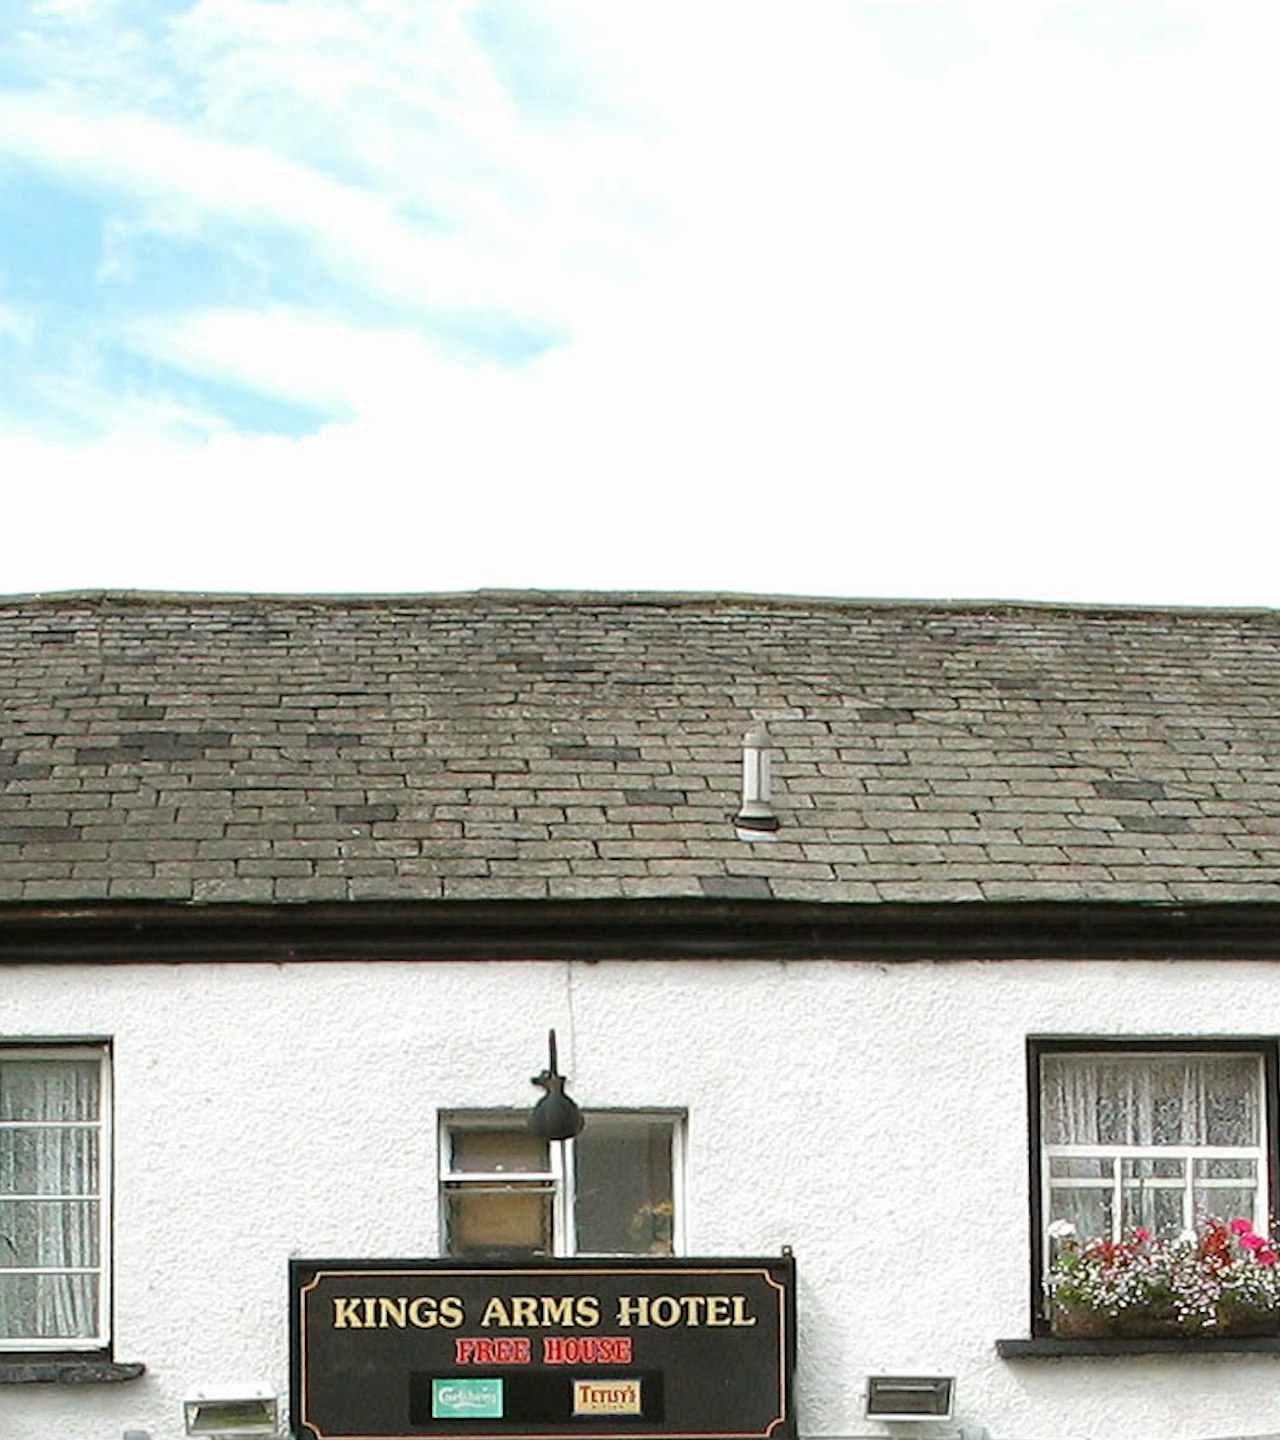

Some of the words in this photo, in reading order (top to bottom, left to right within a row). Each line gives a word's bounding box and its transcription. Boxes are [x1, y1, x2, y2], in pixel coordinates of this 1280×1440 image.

[333, 1296, 463, 1329] KINGS
[480, 1296, 601, 1328] ARMS
[620, 1296, 757, 1327] HOTEL
[455, 1336, 531, 1364] FREE
[543, 1336, 633, 1364] HOUSE
